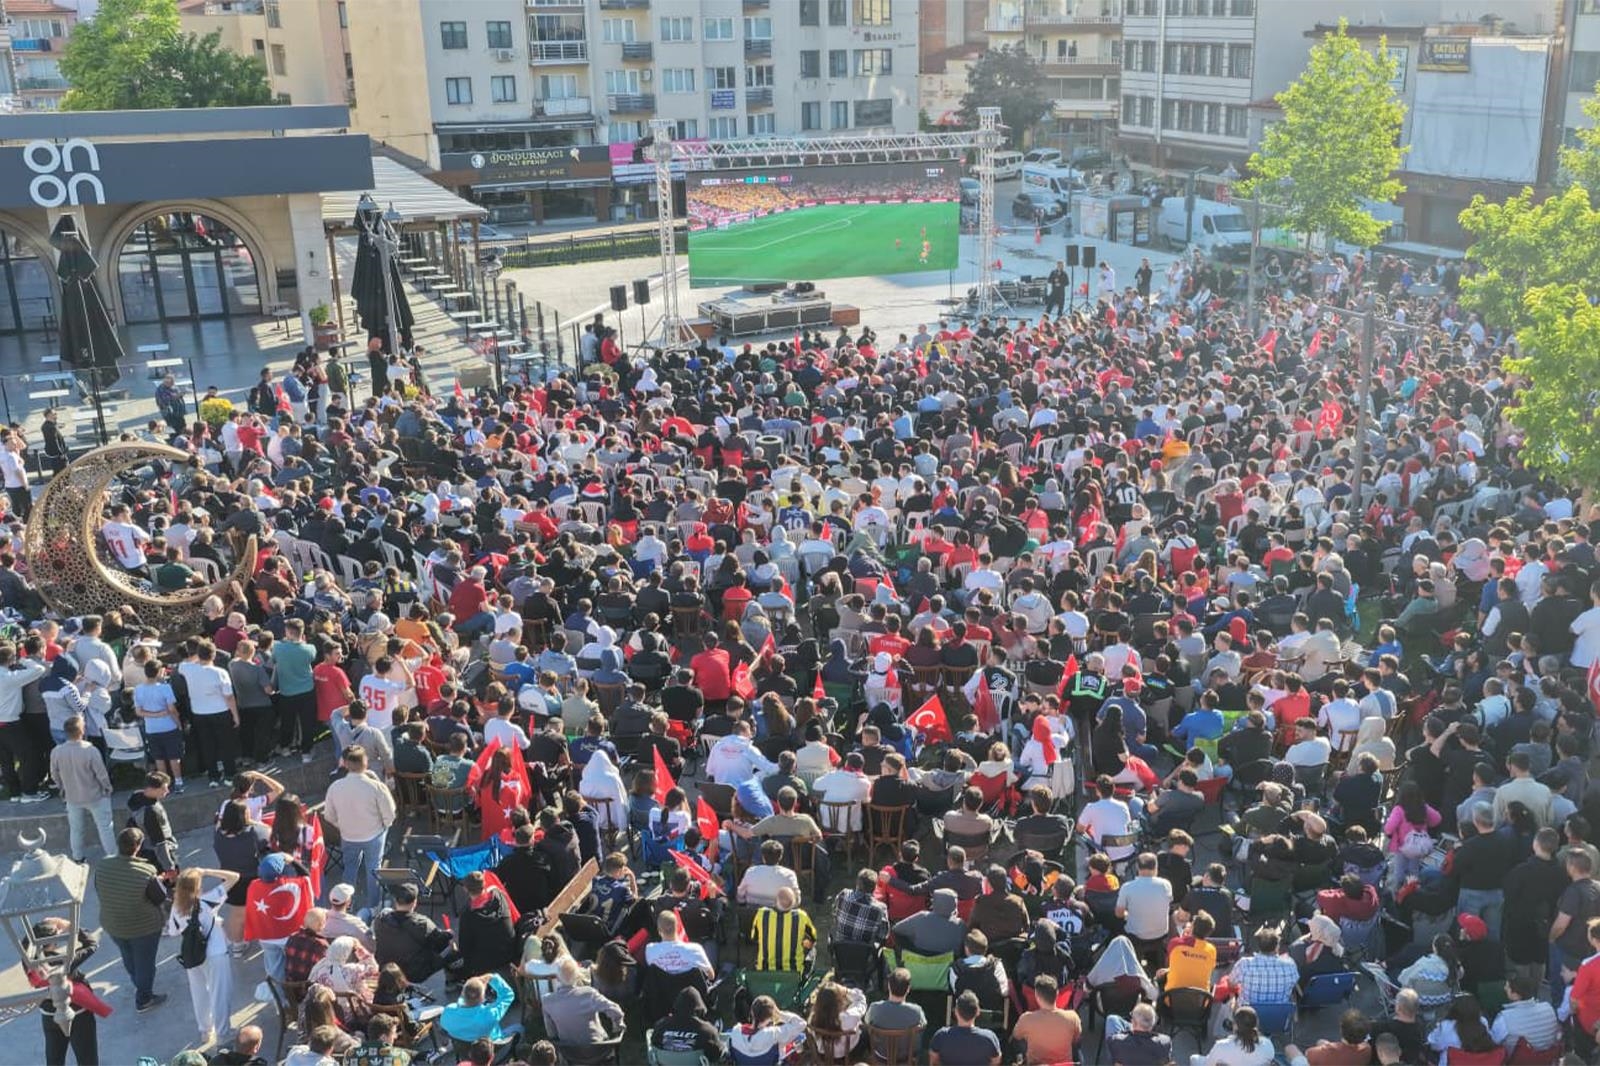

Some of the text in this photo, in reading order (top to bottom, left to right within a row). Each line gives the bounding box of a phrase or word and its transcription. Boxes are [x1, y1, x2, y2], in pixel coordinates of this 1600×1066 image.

[1115, 487, 1137, 504] 10
[784, 517, 804, 530] 10
[415, 673, 431, 690] 11
[362, 685, 386, 712] 35
